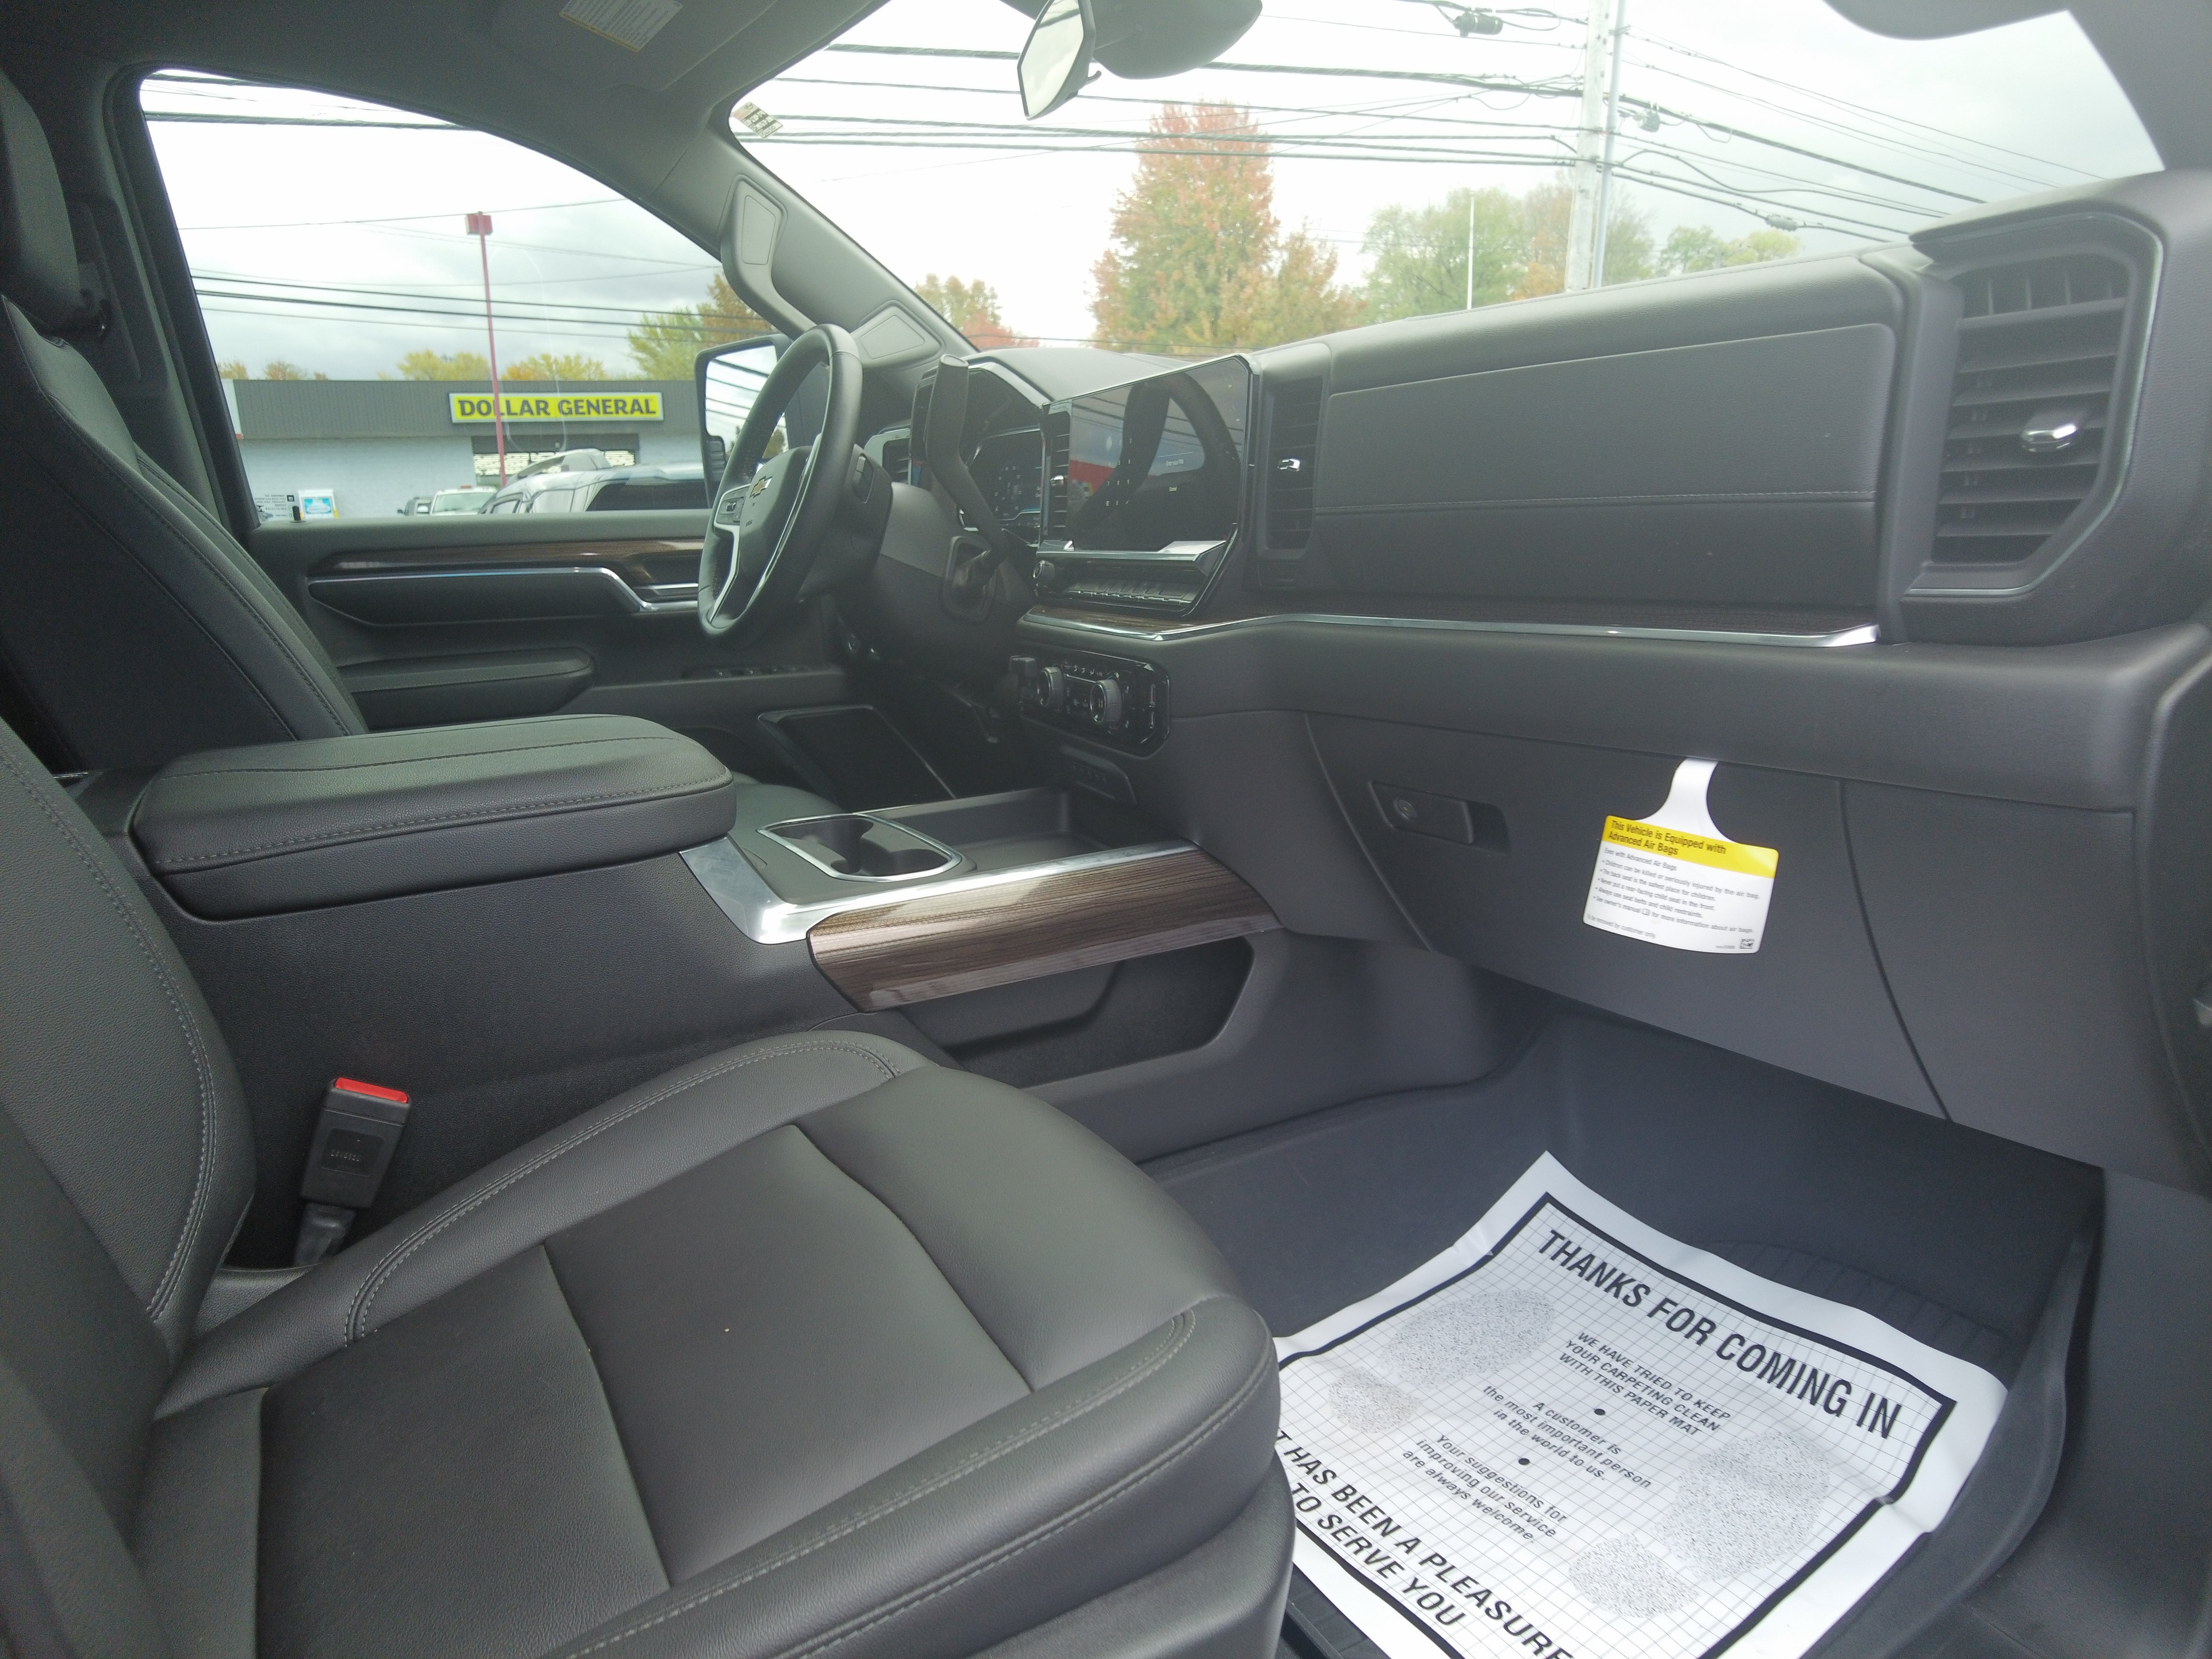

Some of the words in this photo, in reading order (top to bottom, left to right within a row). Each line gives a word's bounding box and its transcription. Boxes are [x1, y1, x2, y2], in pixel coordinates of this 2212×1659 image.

[558, 399, 656, 416] GENERAL
[1609, 831, 1642, 846] Advanced
[1644, 840, 1656, 849] Air
[1658, 842, 1678, 855] Bags
[1611, 821, 1624, 830] This
[1627, 823, 1653, 837] Vehicle
[1656, 830, 1662, 840] is
[1665, 832, 1704, 849] Equipped
[1706, 843, 1726, 854] with
[1627, 854, 1652, 865] Advanced
[1662, 862, 1677, 871] Bags
[1623, 904, 1640, 913] manual
[1676, 918, 1709, 929] information
[1642, 869, 1657, 878] killed
[1665, 876, 1691, 887] seriously
[1693, 882, 1713, 891] injured
[1648, 881, 1665, 890] safest
[1691, 891, 1716, 902] children.
[1538, 1230, 1651, 1308] THANKS
[1647, 1297, 1717, 1346] FOR
[1716, 1333, 1852, 1418] COMING
[1856, 1393, 1902, 1440] IN
[1578, 1332, 1600, 1348] WE
[1598, 1344, 1634, 1368] HAVE
[1634, 1365, 1672, 1390] TRIED
[1674, 1388, 1693, 1401] TO
[1693, 1399, 1731, 1419] KEEP
[1560, 1353, 1594, 1376] WITH
[1593, 1373, 1624, 1393] THIS
[1623, 1392, 1669, 1419] PAPER
[1669, 1416, 1702, 1436] MAT
[1565, 1340, 1600, 1364] YOUR
[1600, 1362, 1673, 1406] CARPETING
[1674, 1404, 1721, 1431] CLEAN
[1483, 1385, 1504, 1402] the
[1504, 1401, 1539, 1423] most
[1537, 1420, 1603, 1459] important
[1600, 1458, 1652, 1488] person
[1493, 1409, 1508, 1420] in
[1508, 1419, 1530, 1436] the
[1531, 1433, 1570, 1457] world
[1569, 1454, 1585, 1467] to
[1586, 1464, 1605, 1480] us.
[1533, 1402, 1545, 1411] A
[1545, 1409, 1607, 1445] customer
[1607, 1443, 1622, 1455] is
[1403, 1451, 1425, 1468] are
[1425, 1468, 1471, 1500] always
[1472, 1498, 1534, 1543] welcome.
[1416, 1440, 1480, 1489] improving
[1480, 1486, 1505, 1502] our
[1504, 1502, 1557, 1537] service
[1436, 1435, 1466, 1457] Your
[1465, 1456, 1544, 1509] suggestions
[1544, 1505, 1567, 1523] for
[1276, 1430, 1292, 1441] T
[1284, 1447, 1337, 1484] HAS
[1331, 1484, 1402, 1537] BEEN
[1394, 1538, 1421, 1554] A
[1419, 1552, 1575, 1659] PLEASURE
[1291, 1482, 1321, 1512] TO
[1318, 1515, 1406, 1579] SERVE
[1401, 1577, 1466, 1625] YOU
